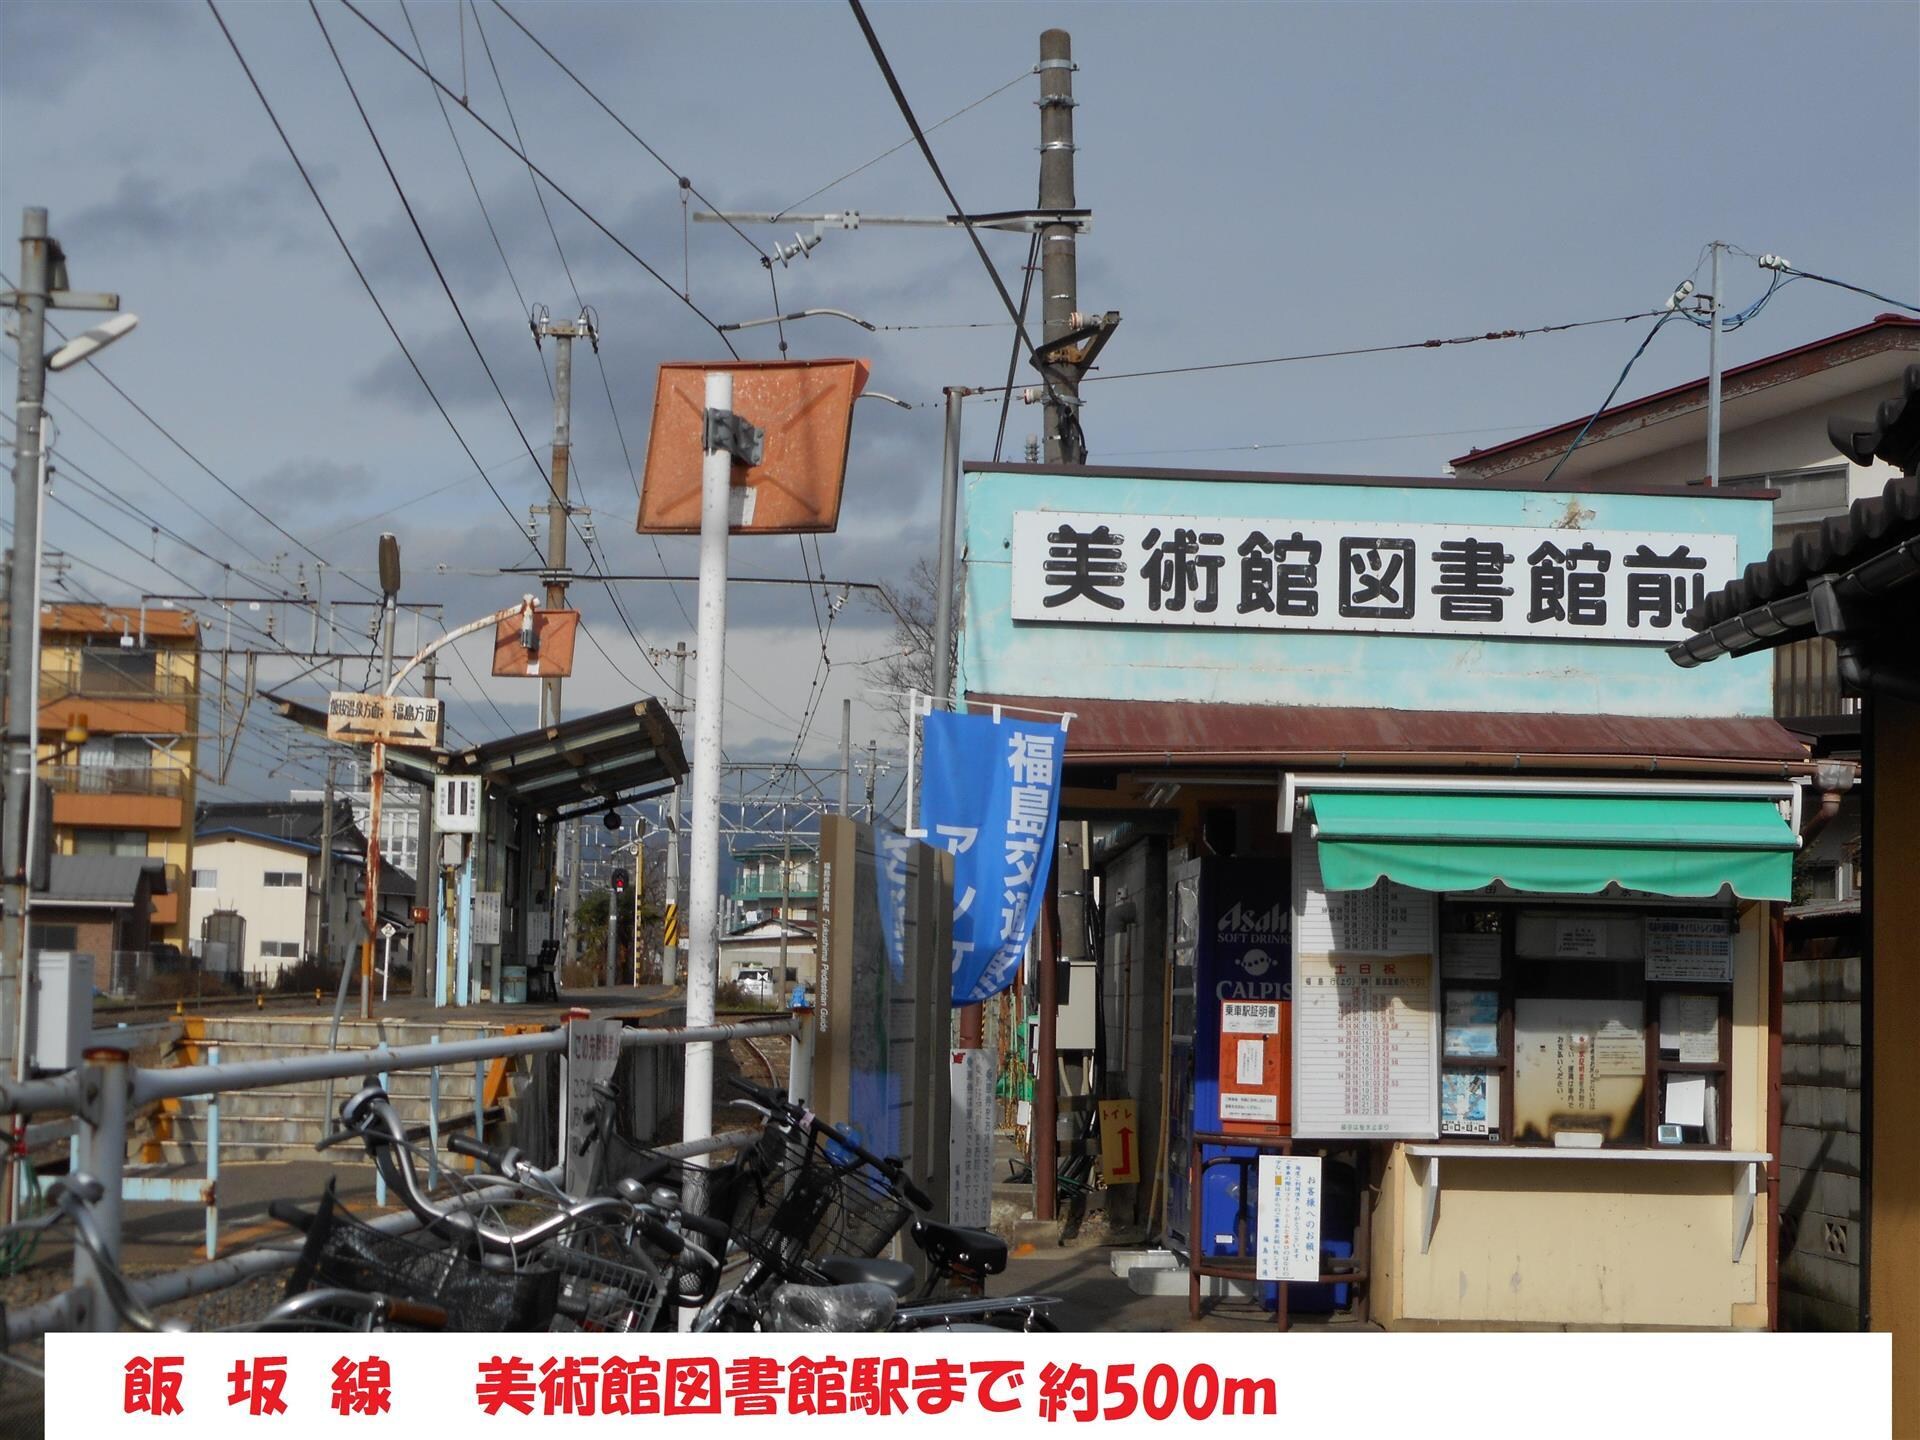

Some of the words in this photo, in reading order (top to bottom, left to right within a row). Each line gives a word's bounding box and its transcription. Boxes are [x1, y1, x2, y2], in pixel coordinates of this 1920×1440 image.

[1043, 524, 1708, 630] 美術館図書館前
[330, 699, 381, 719] 飯坂温泉方面
[393, 703, 437, 722] 福島方面
[822, 917, 831, 962] Fukushima
[1217, 932, 1248, 943] SOFT
[1250, 933, 1291, 945] DRINK
[1335, 964, 1347, 974] 土
[1360, 964, 1371, 974] 日
[1383, 964, 1396, 974] 祝
[821, 963, 830, 1007] Pedestrian
[820, 1007, 829, 1033] Guide
[1225, 1004, 1276, 1018] 乗車駅証明書
[1103, 1108, 1133, 1120] トイレ
[1305, 1176, 1316, 1262] お客様へのお願い
